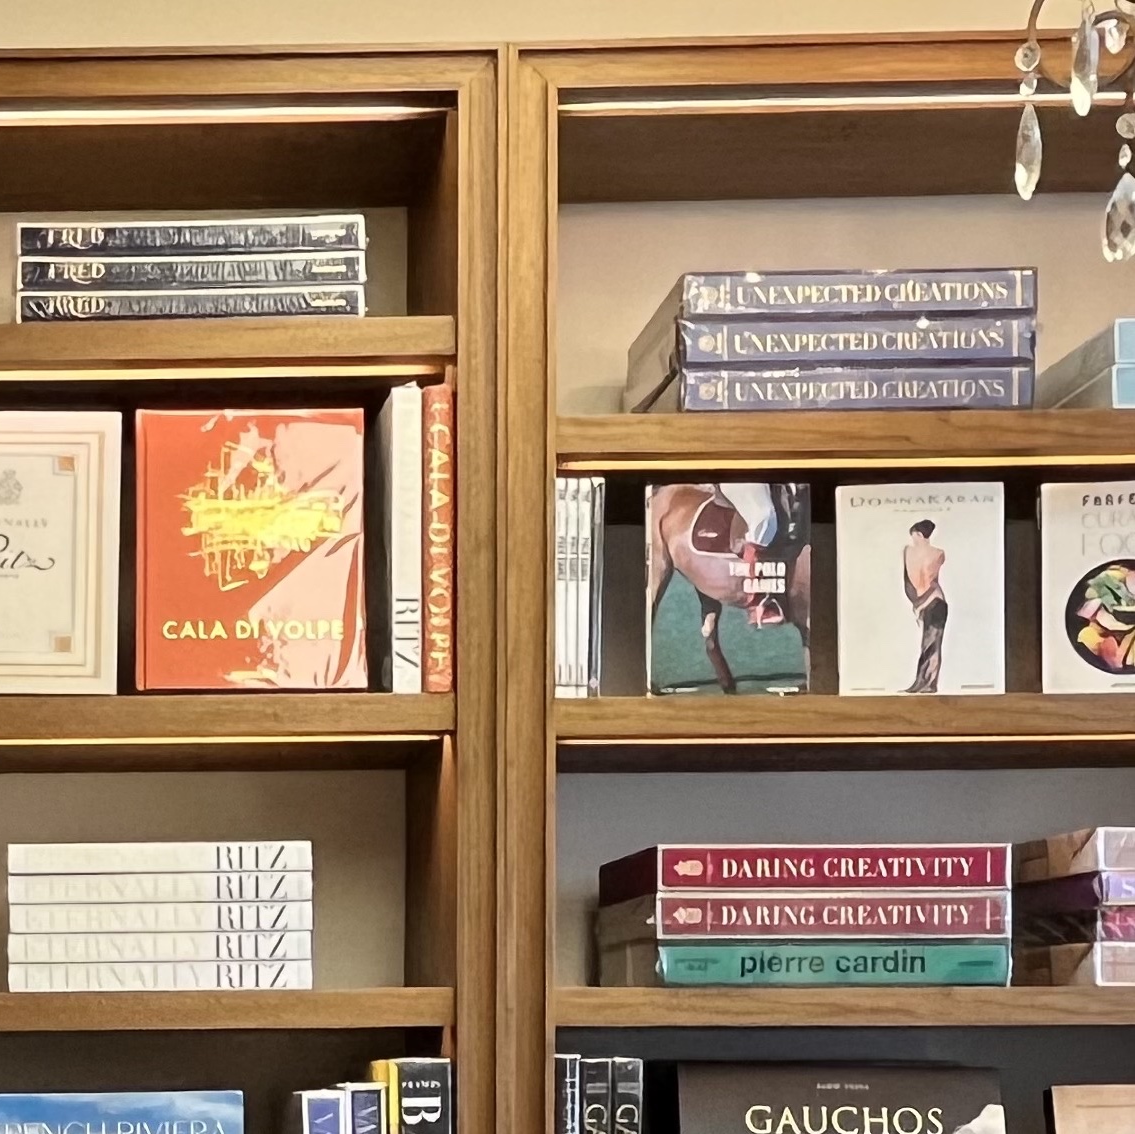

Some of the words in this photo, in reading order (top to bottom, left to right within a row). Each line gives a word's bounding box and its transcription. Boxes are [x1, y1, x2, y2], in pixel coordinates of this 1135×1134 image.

[737, 284, 882, 306] UNEXPECTED
[884, 280, 1008, 302] CREATIONS
[734, 333, 878, 354] UNEXPECTED
[880, 329, 1004, 350] CREATIONS
[735, 381, 878, 401] UNEXPECTED
[882, 379, 1005, 400] CREATIONS
[162, 620, 228, 641] CALA
[235, 620, 262, 641] DI
[266, 619, 344, 641] VOLPE
[395, 598, 419, 669] RITZ
[216, 845, 287, 869] RITZ
[722, 858, 815, 880] DARING
[823, 857, 974, 880] CREATIVITY
[216, 875, 287, 899] RITZ
[217, 904, 287, 930] RITZ
[721, 905, 815, 926] DARING
[823, 904, 971, 926] CREATIVITY
[216, 934, 287, 958] RITZ
[740, 953, 825, 977] pierre
[836, 949, 926, 974] cardin
[216, 963, 287, 988] RITZ
